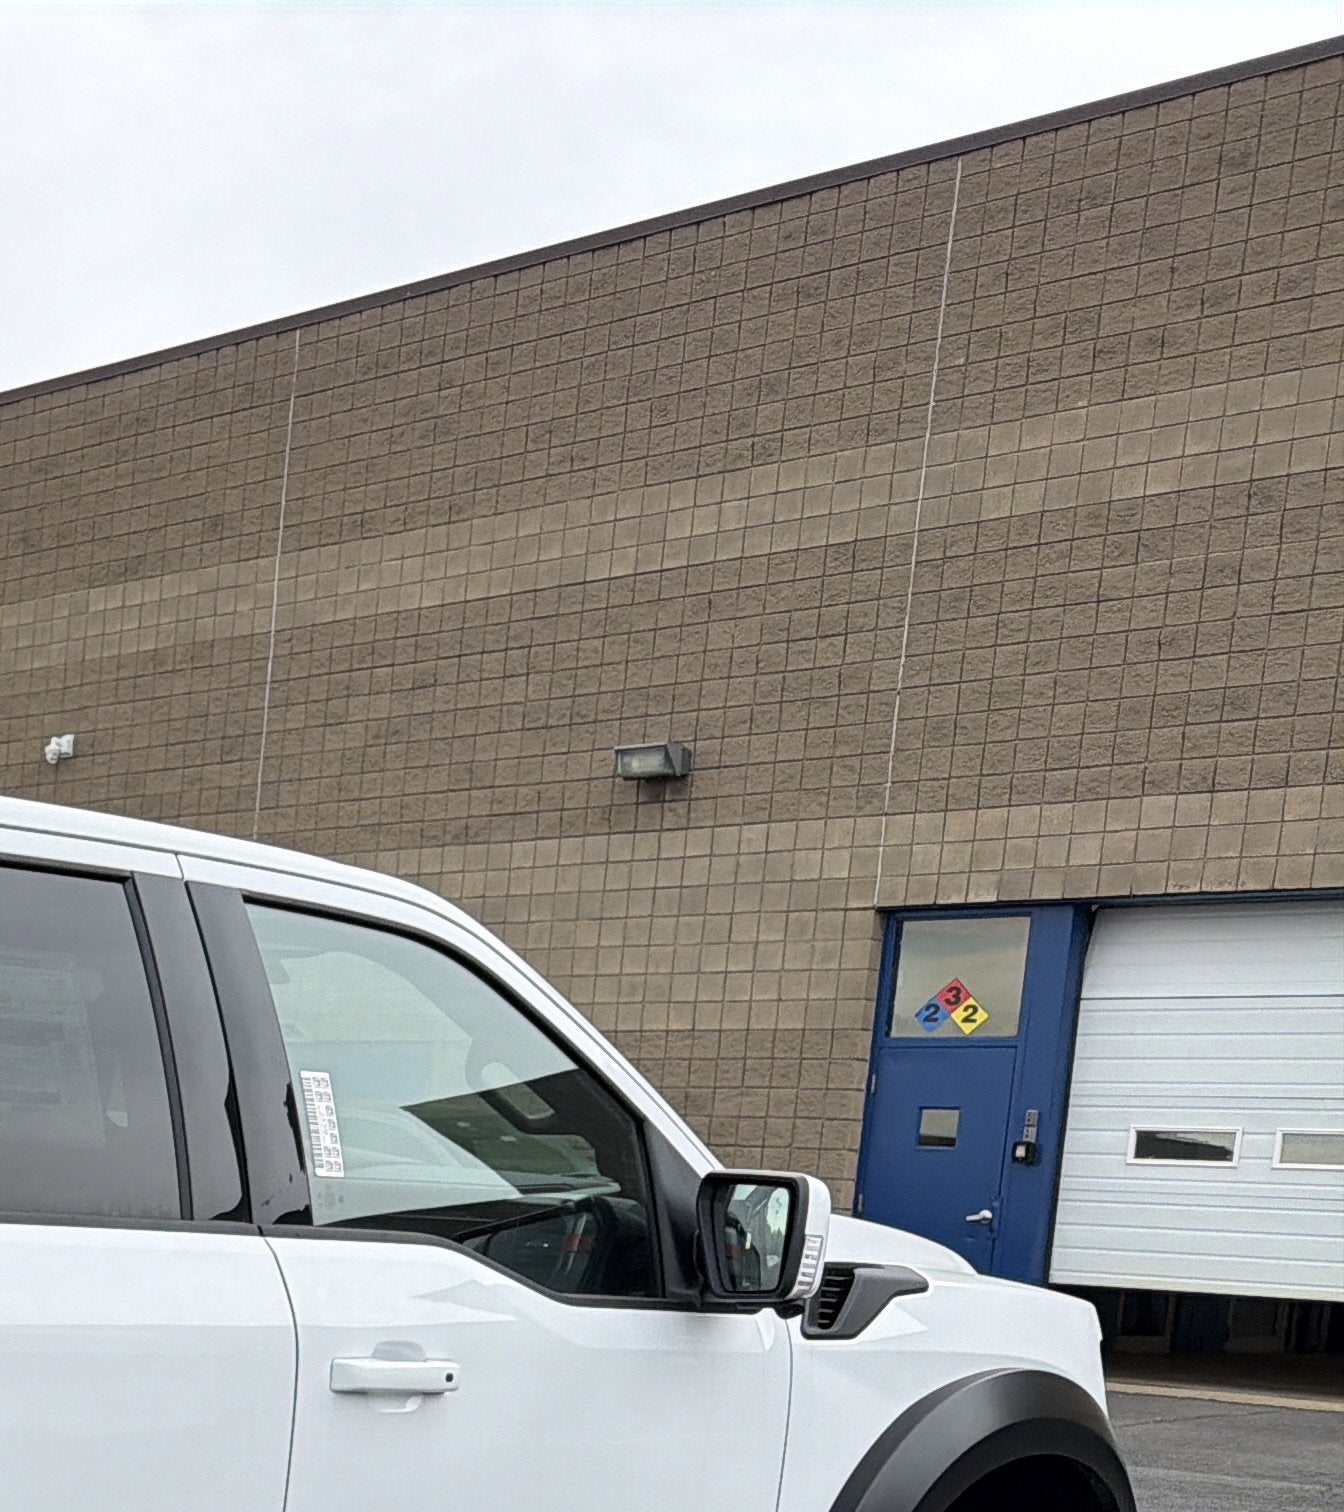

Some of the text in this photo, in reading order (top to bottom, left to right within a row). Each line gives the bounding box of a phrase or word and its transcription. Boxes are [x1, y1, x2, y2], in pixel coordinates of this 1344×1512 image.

[944, 985, 962, 1006] 3
[923, 1003, 940, 1023] 2
[961, 1004, 979, 1024] 2
